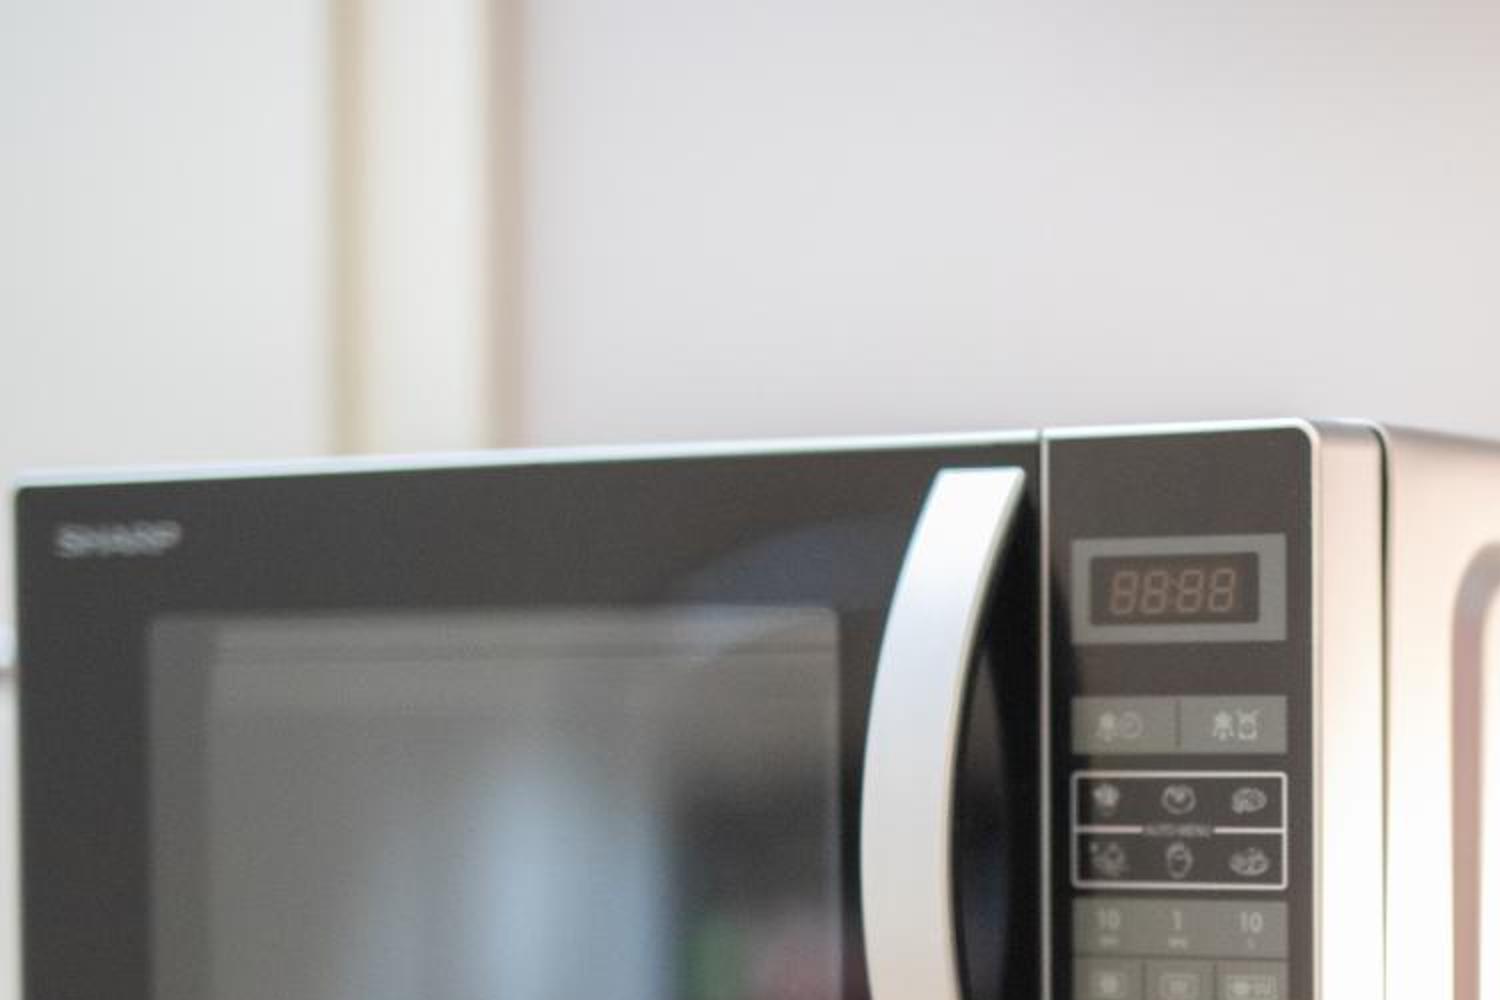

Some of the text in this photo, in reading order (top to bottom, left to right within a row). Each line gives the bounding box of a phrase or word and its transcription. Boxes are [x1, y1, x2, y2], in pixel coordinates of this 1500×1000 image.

[56, 521, 182, 558] SHARP
[1096, 909, 1121, 931] 10
[1239, 911, 1264, 934] 10
